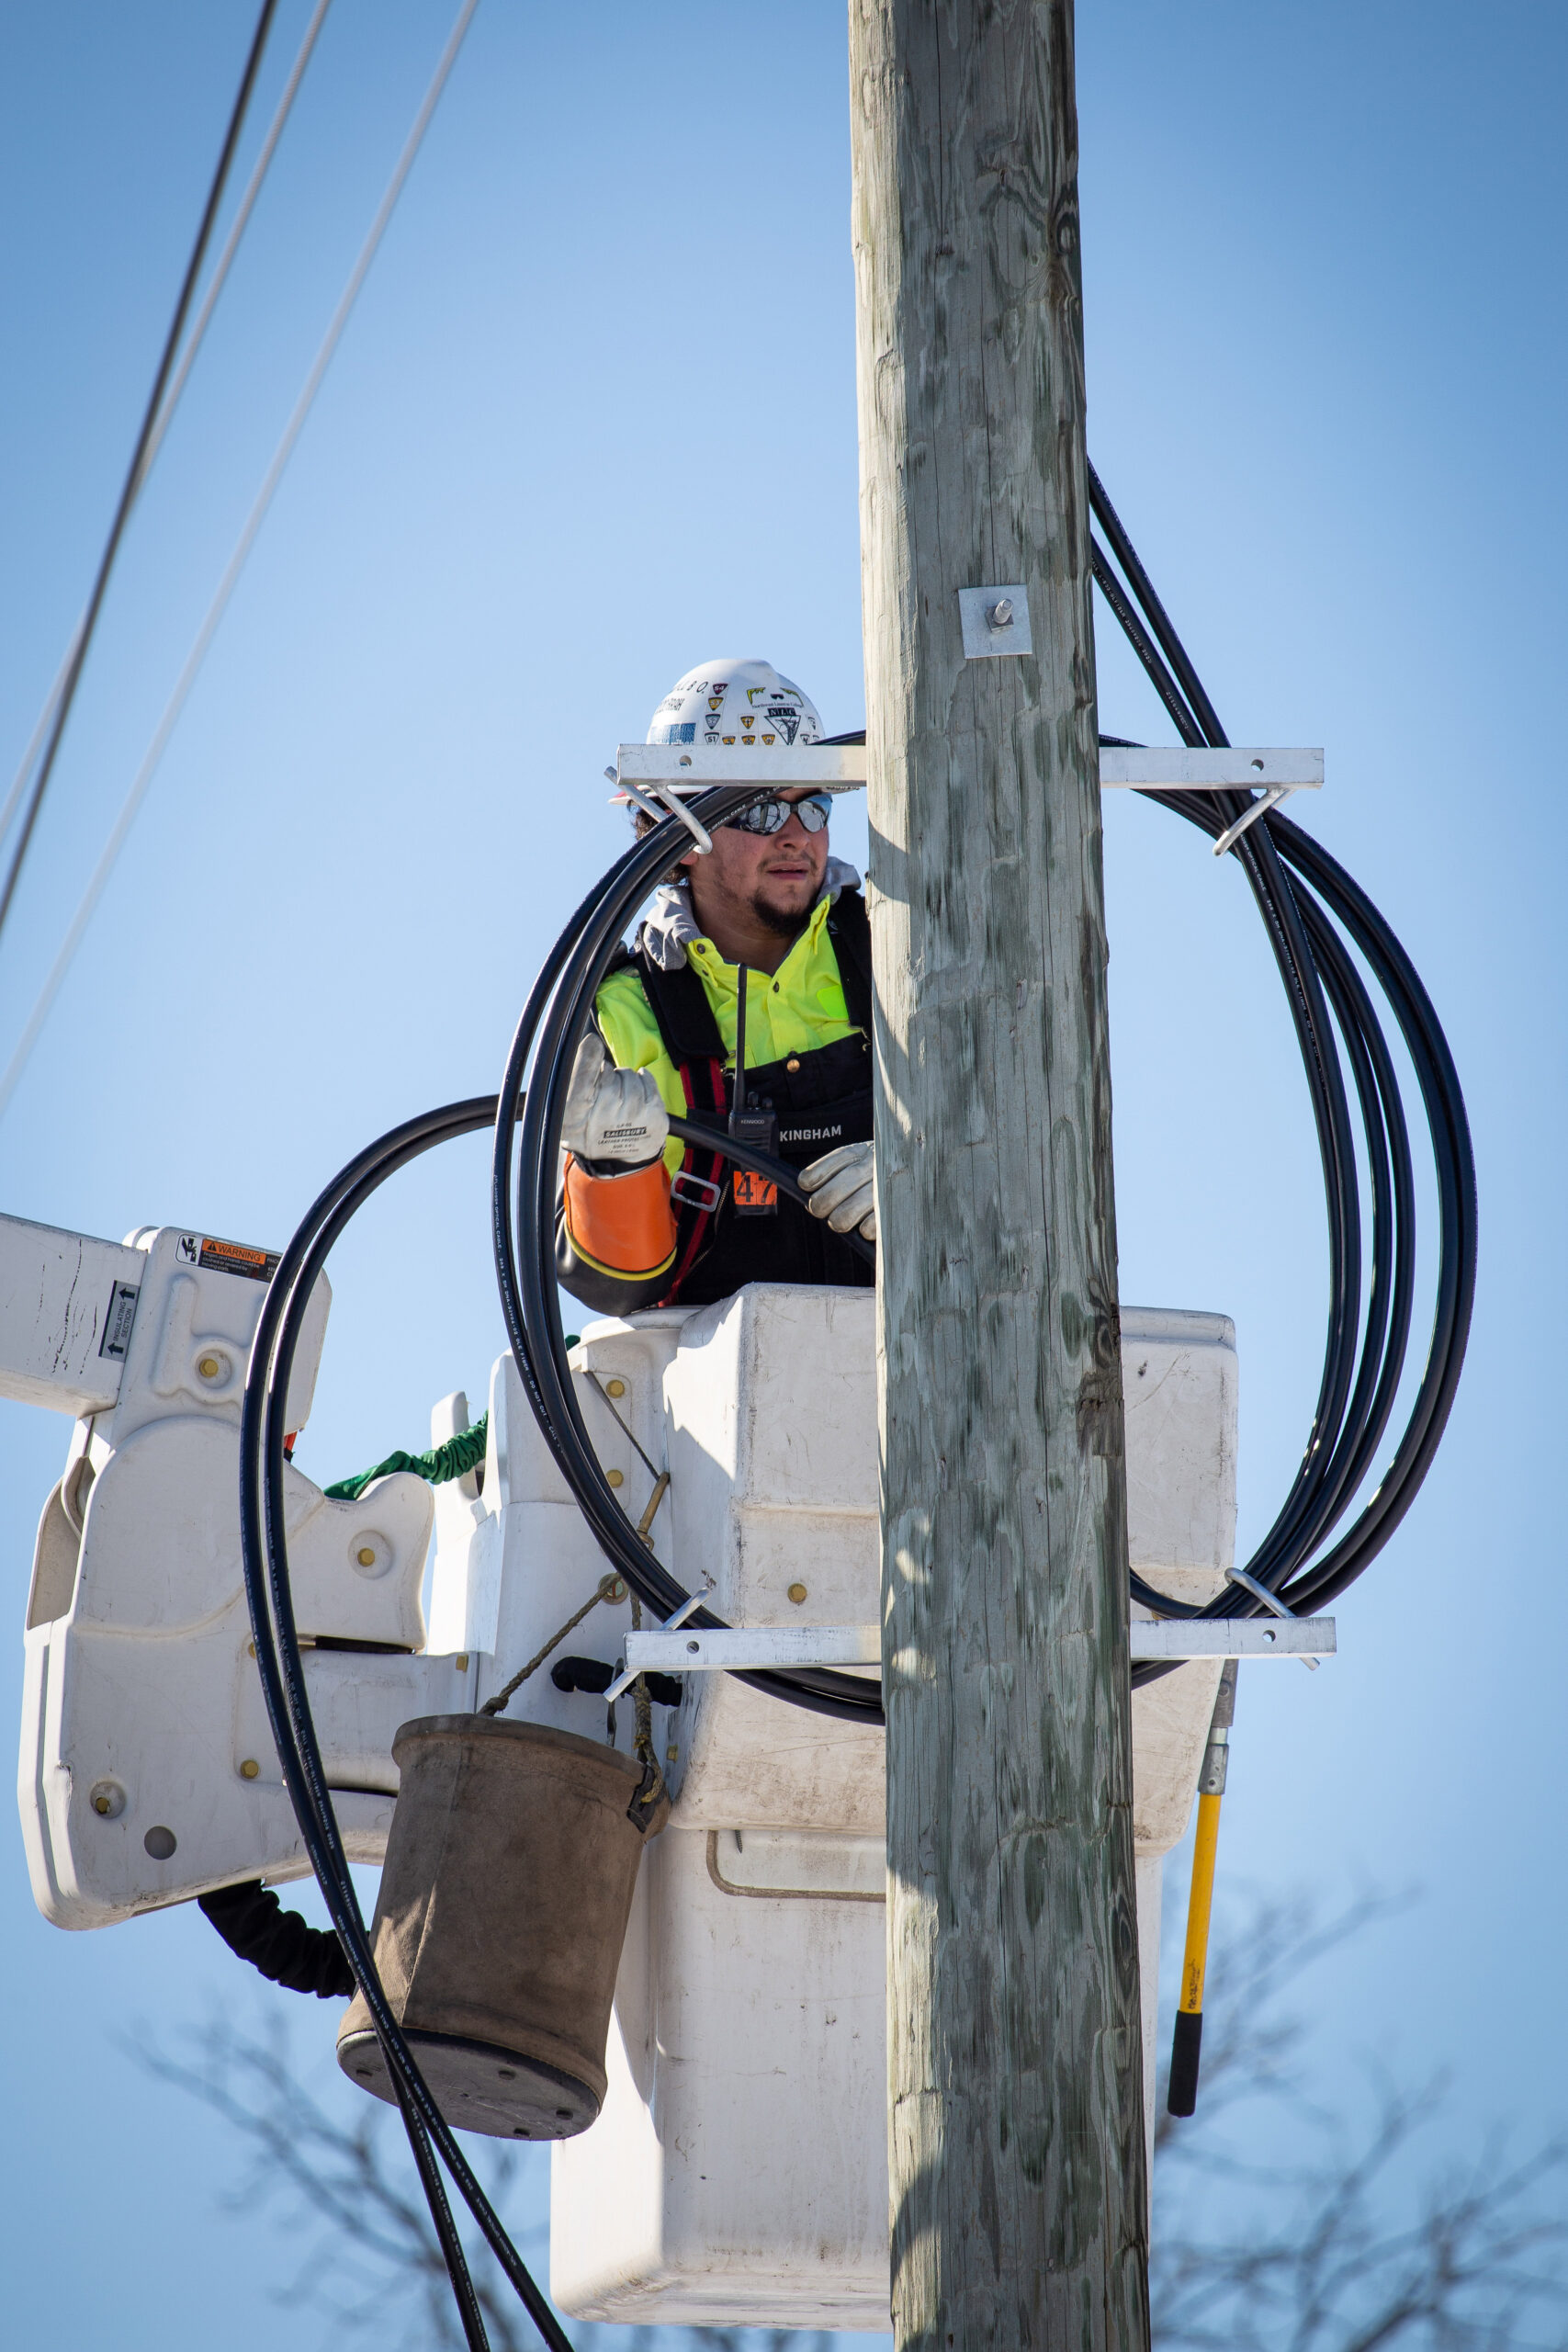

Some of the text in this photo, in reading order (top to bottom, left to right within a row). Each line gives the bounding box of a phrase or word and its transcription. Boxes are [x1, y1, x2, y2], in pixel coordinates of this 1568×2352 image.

[779, 1125, 841, 1142] KINGHAM
[736, 1173, 775, 1204] 47
[219, 1245, 261, 1261] WARNING
[113, 1301, 127, 1342] INSULATING
[120, 1308, 132, 1339] SECTION
